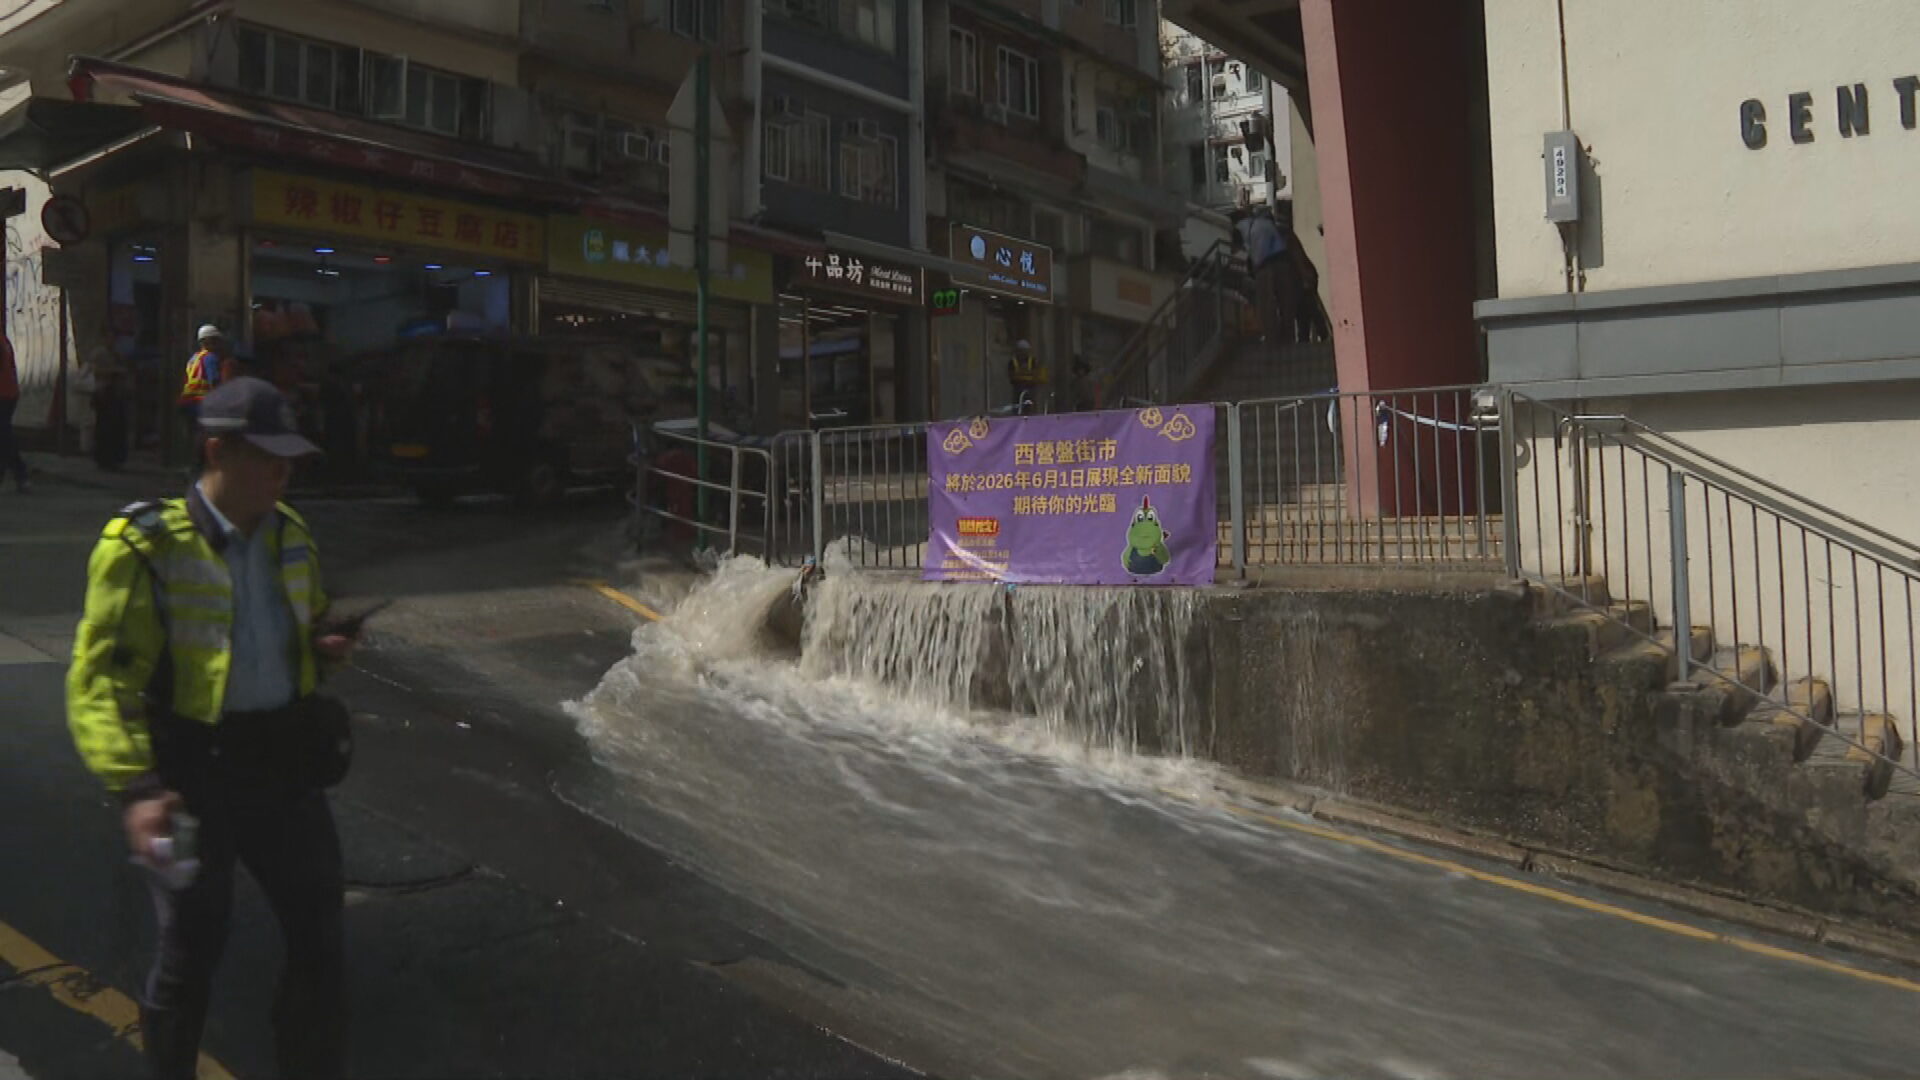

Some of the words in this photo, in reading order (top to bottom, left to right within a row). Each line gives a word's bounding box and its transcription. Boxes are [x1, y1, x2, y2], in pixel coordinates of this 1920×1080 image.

[1555, 149, 1565, 195] 49294
[283, 184, 520, 249] 辣椒仔豆腐店
[1014, 437, 1118, 466] 西營盤街市
[1013, 492, 1117, 515] 期待你的光臨
